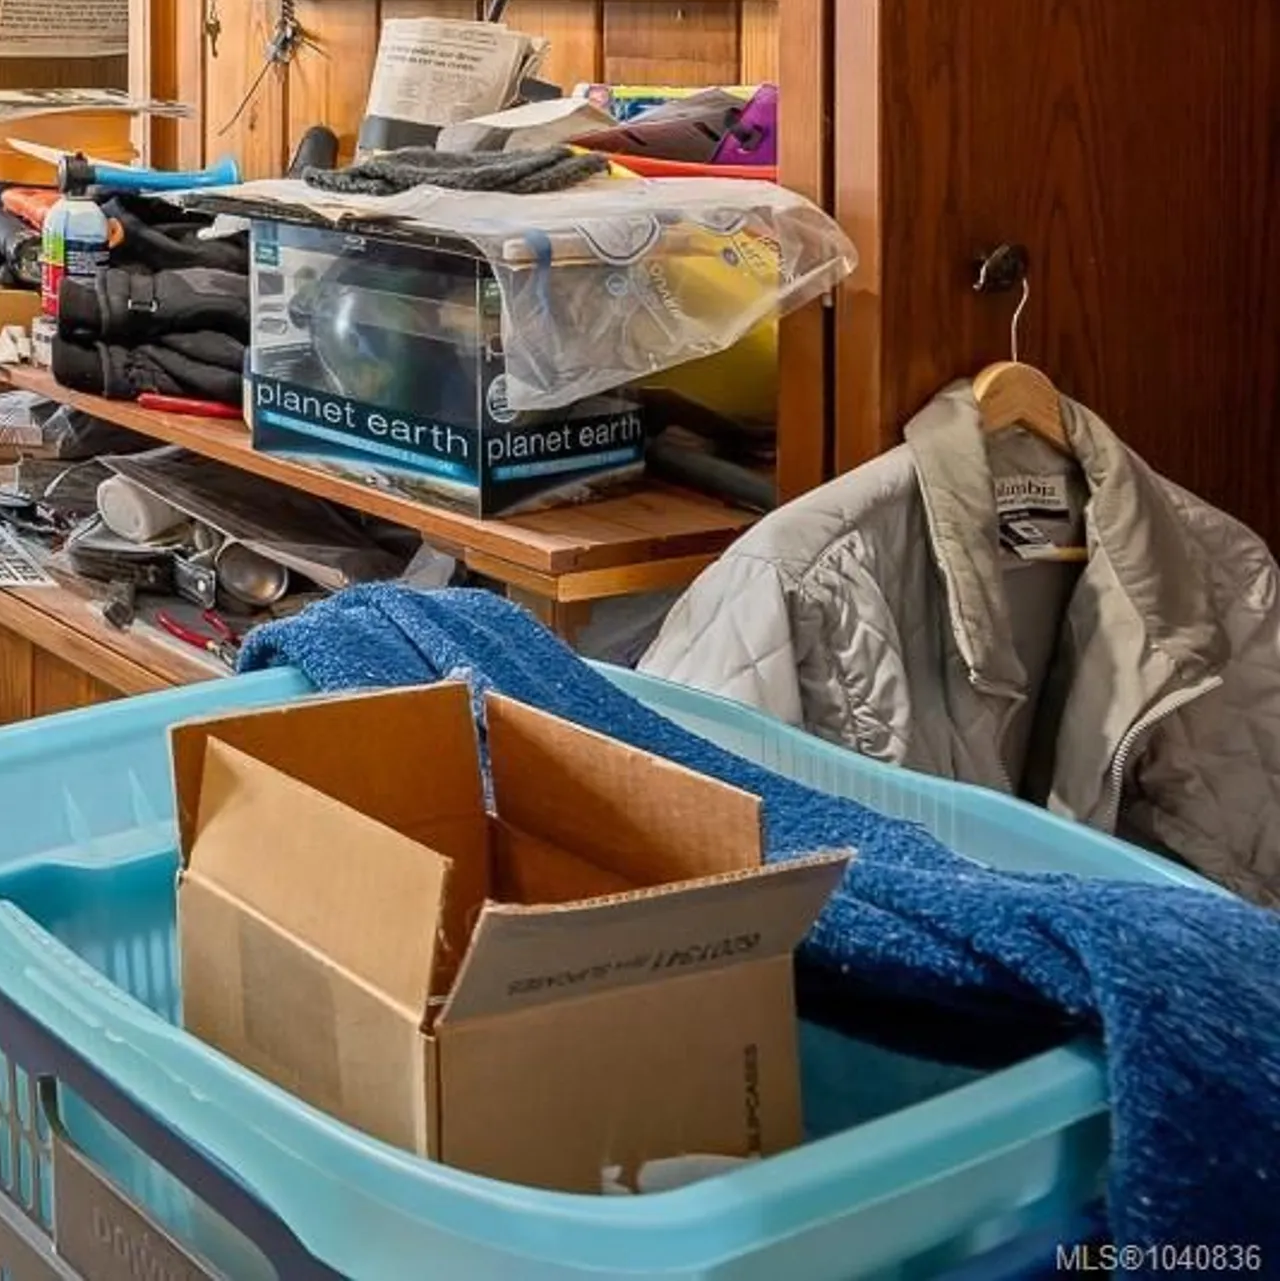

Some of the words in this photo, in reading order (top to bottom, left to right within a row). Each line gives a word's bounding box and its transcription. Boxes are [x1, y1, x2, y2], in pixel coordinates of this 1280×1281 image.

[257, 382, 356, 428] planet
[367, 413, 468, 457] earth
[488, 425, 571, 467] planet
[578, 414, 642, 447] earth
